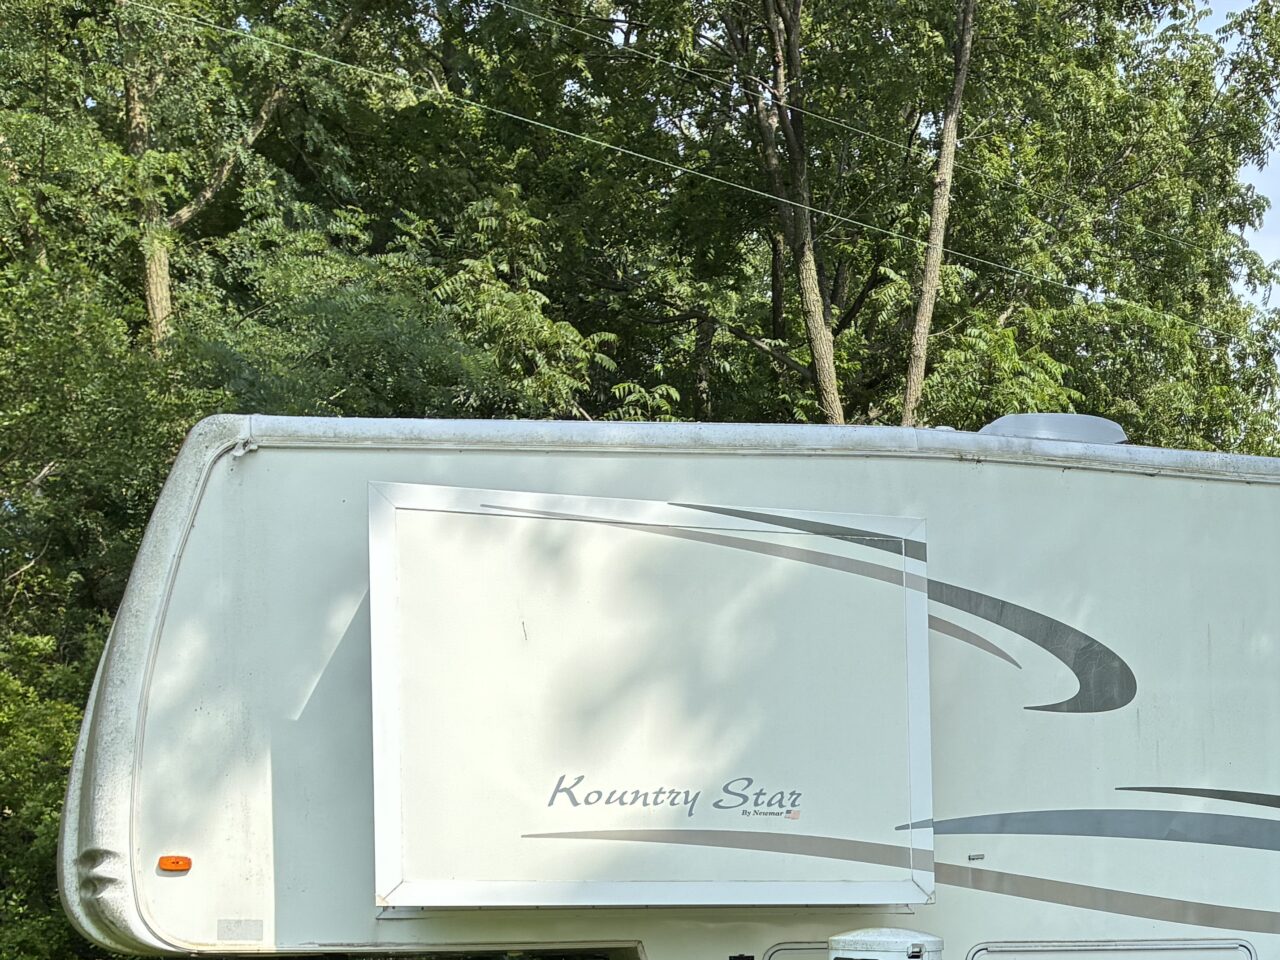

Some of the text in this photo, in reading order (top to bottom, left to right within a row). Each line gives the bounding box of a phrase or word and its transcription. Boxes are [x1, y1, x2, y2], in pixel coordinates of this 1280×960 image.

[547, 774, 803, 818] Kountry Star
[741, 809, 785, 817] By Newmar
